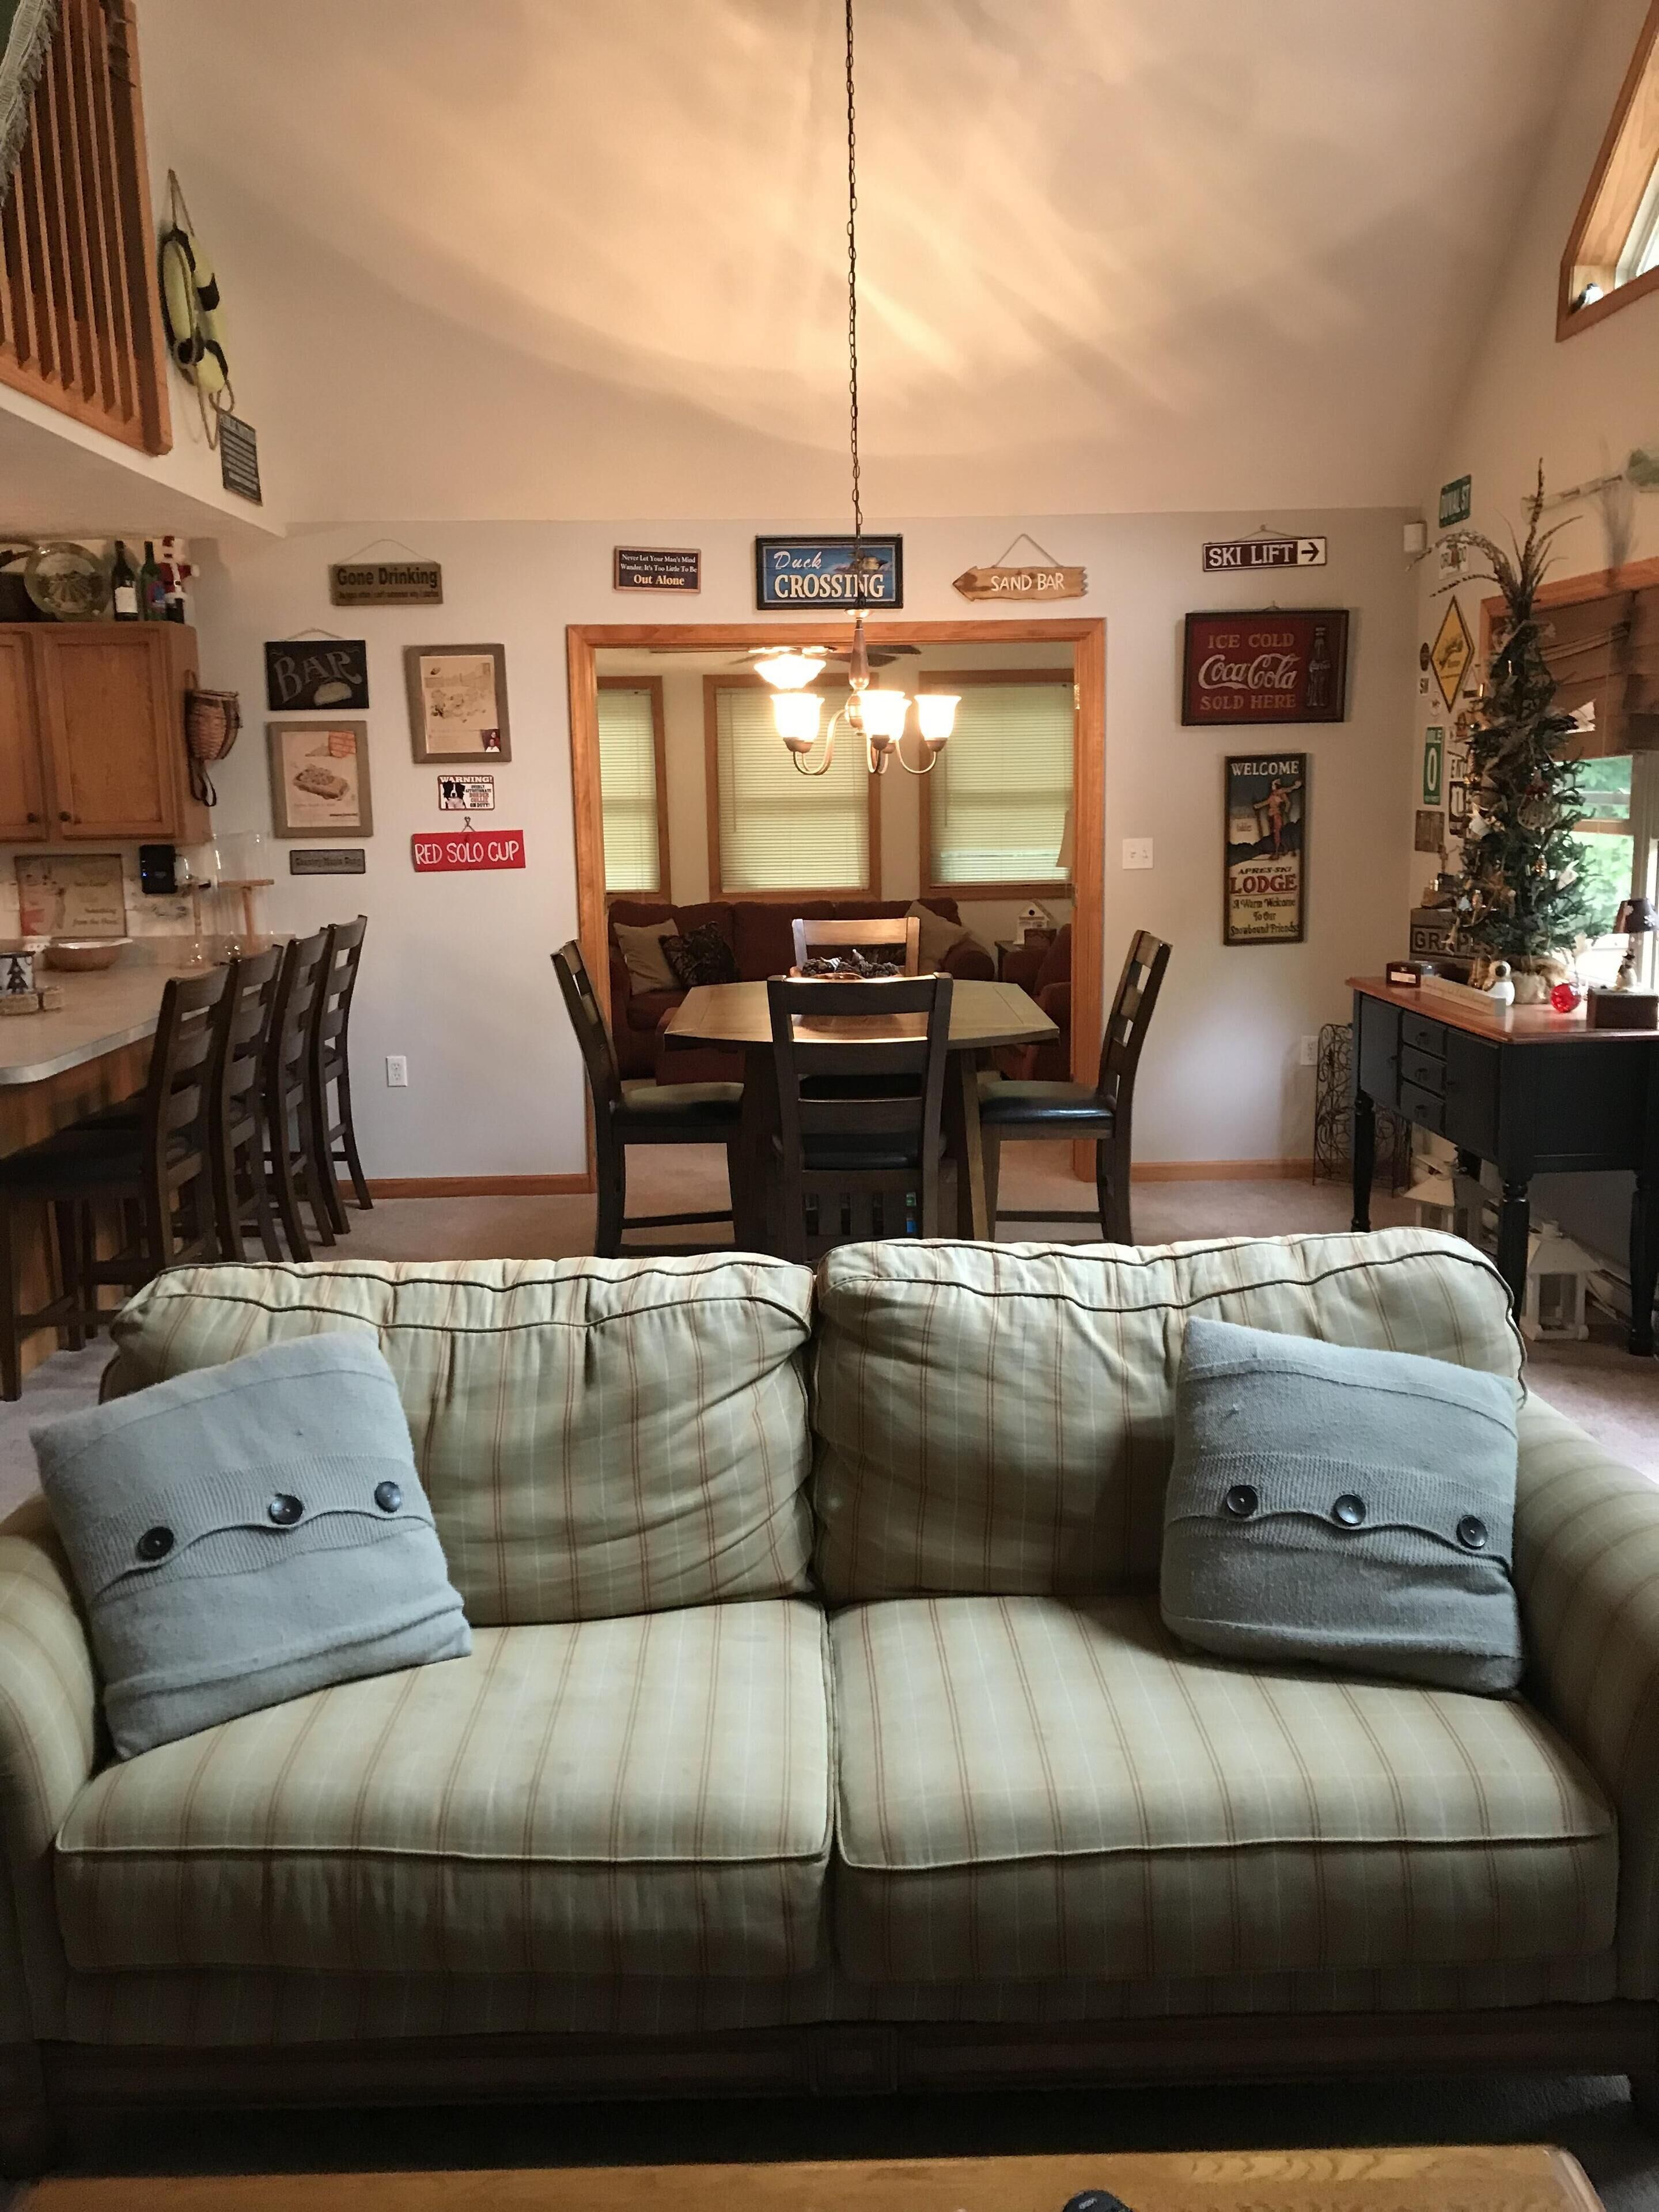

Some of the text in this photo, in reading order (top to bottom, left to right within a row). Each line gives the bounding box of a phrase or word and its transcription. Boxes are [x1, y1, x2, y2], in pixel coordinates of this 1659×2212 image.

[774, 551, 823, 570] Duck
[1209, 544, 1294, 567] SKI LIFT
[337, 567, 438, 588] Gone Drinking
[634, 574, 685, 585] Out Alone
[774, 573, 885, 598] CROSSING
[990, 572, 1066, 592] SAND BAR
[1207, 633, 1295, 649] ICE COLD
[273, 651, 363, 703] BAR
[1199, 693, 1296, 710] SOLD HERE
[1230, 760, 1300, 776] WELCOME
[414, 840, 519, 865] RED SOLO CUP
[1229, 874, 1298, 894] LODGE
[1241, 898, 1263, 908] Warm
[1264, 897, 1296, 907] Welcome
[1253, 911, 1277, 921] To Our
[1230, 923, 1268, 936] Snowbound
